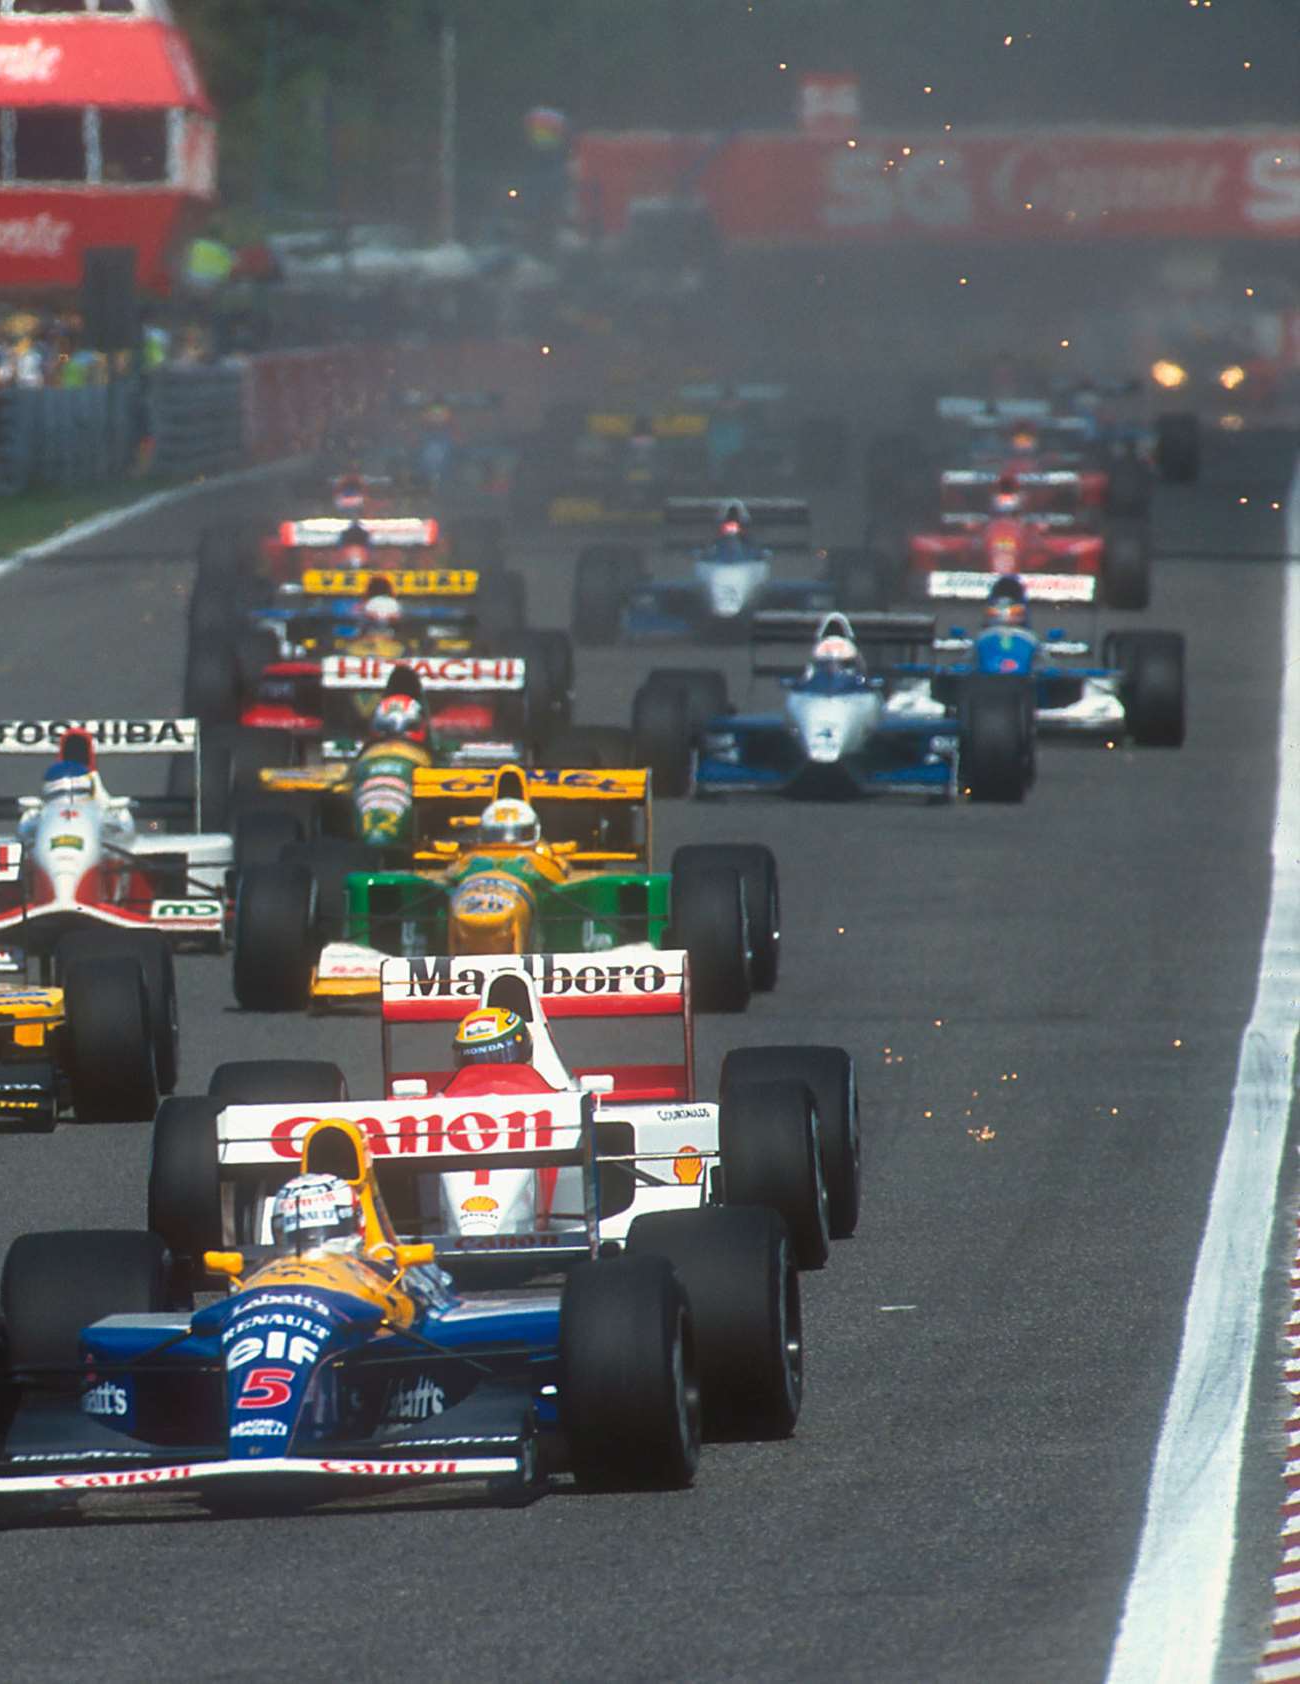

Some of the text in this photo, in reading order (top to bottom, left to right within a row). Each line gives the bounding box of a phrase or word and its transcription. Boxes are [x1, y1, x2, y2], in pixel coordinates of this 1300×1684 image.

[363, 809, 398, 833] 12
[406, 953, 666, 998] Malboro
[270, 1109, 552, 1158] Canon
[232, 1293, 331, 1317] Labatt's
[222, 1313, 331, 1345] RENAULT
[227, 1331, 320, 1372] elf
[236, 1367, 296, 1410] 5
